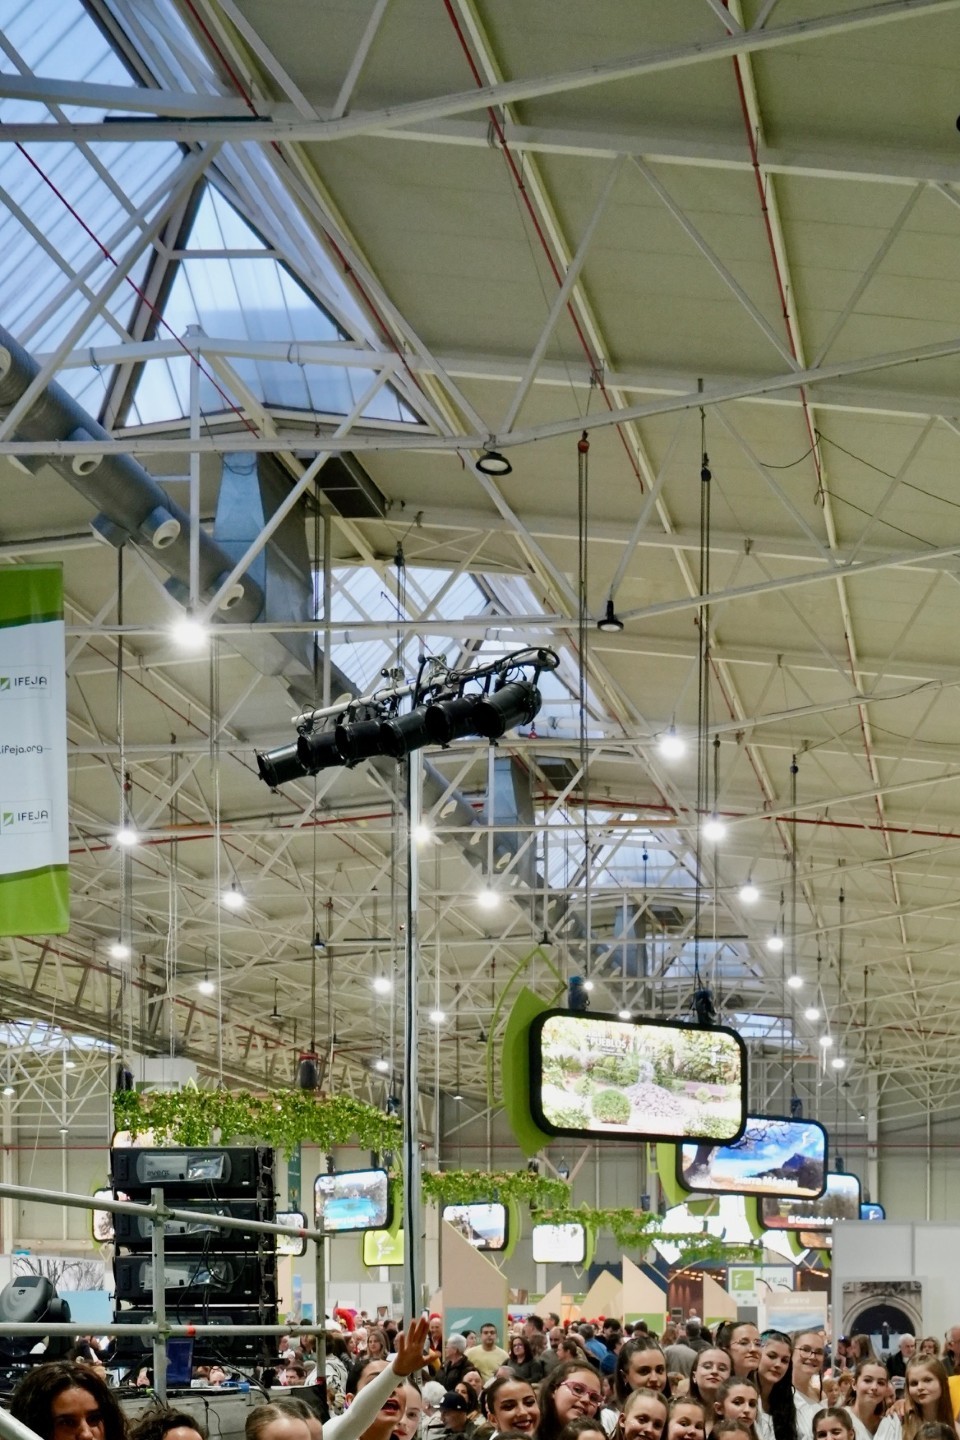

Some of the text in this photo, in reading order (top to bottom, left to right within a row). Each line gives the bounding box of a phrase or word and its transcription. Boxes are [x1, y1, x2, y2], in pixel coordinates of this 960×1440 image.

[14, 676, 48, 686] IFEJA
[17, 810, 49, 821] IFEJA
[590, 1036, 627, 1050] PUEBLOS
